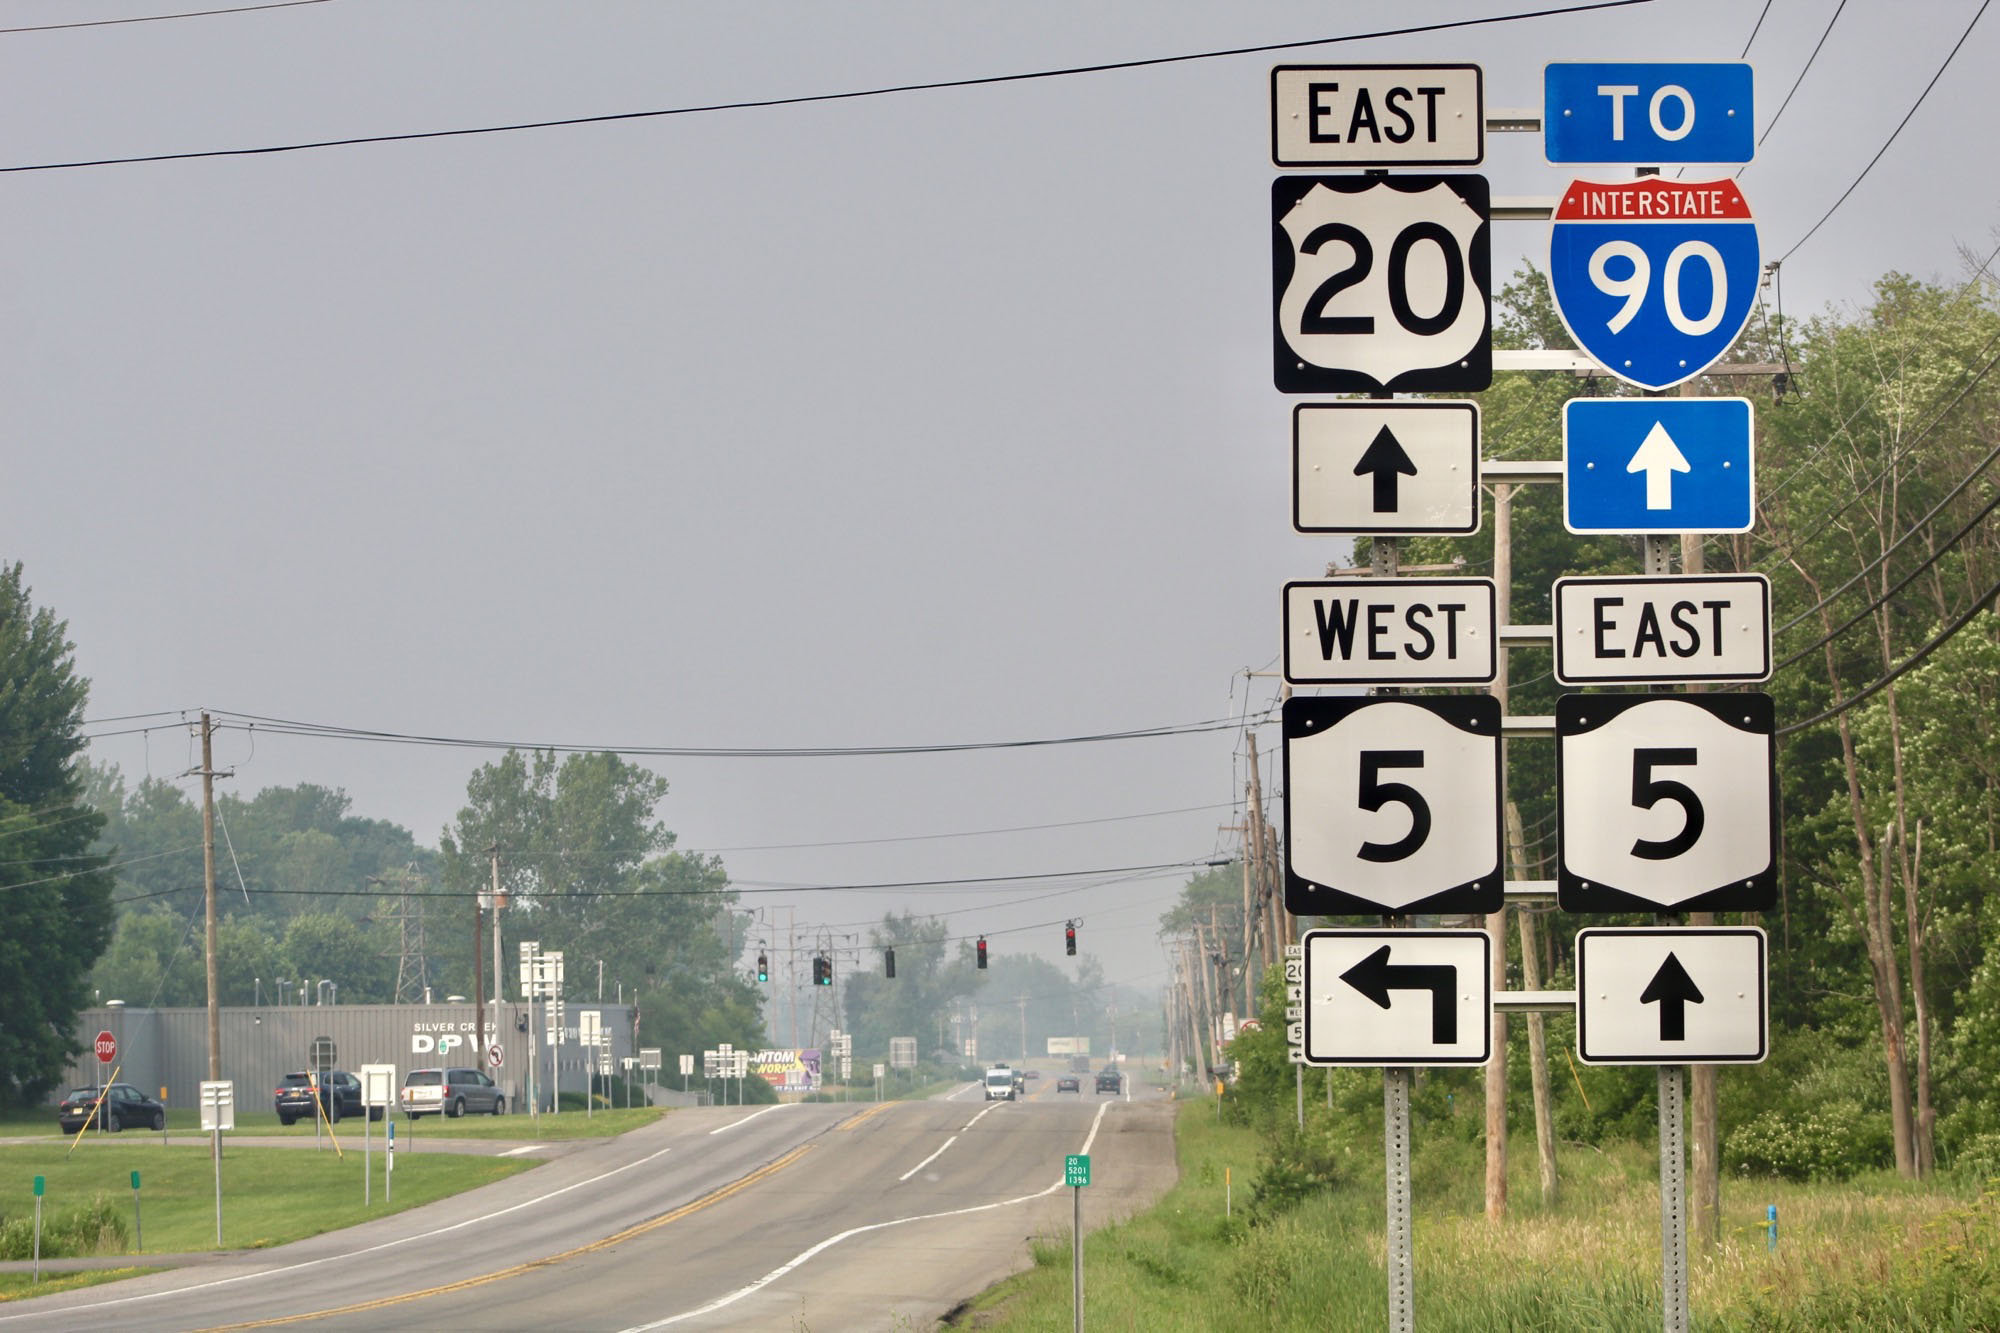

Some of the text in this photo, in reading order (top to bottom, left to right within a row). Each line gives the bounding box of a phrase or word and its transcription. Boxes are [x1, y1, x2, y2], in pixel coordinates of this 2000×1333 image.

[1308, 82, 1446, 144] EAST
[1597, 84, 1696, 141] TO
[1582, 190, 1724, 216] INTERSTATE
[1299, 221, 1465, 336] 20
[1588, 240, 1728, 336] 90
[1313, 598, 1466, 661] WEST
[1593, 597, 1731, 659] EAST
[1356, 750, 1432, 863] 5
[1630, 747, 1705, 861] 5
[1288, 946, 1302, 954] EAS
[97, 1041, 115, 1053] STOP
[414, 1023, 454, 1031] SILVER
[1295, 1027, 1302, 1040] 5
